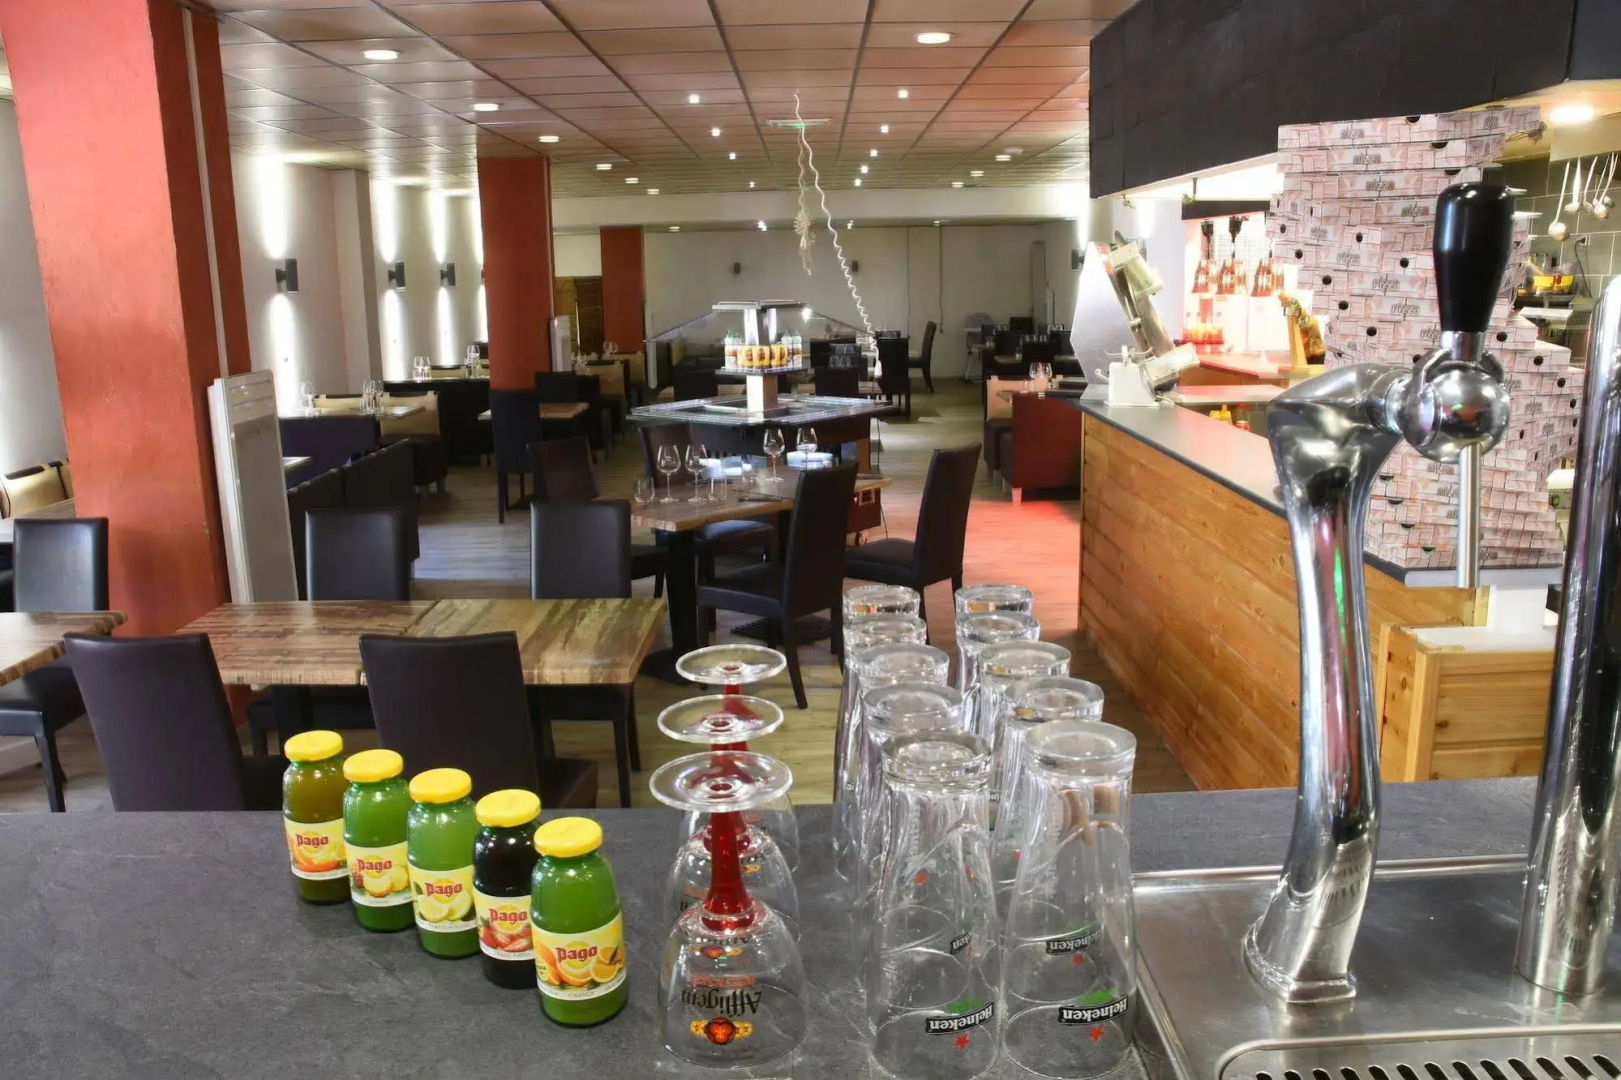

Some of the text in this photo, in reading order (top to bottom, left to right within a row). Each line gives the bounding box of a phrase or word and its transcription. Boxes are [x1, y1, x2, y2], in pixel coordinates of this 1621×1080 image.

[681, 988, 762, 1017] Affligem
[1062, 996, 1128, 1023] Heineken
[928, 1004, 993, 1031] Heineken
